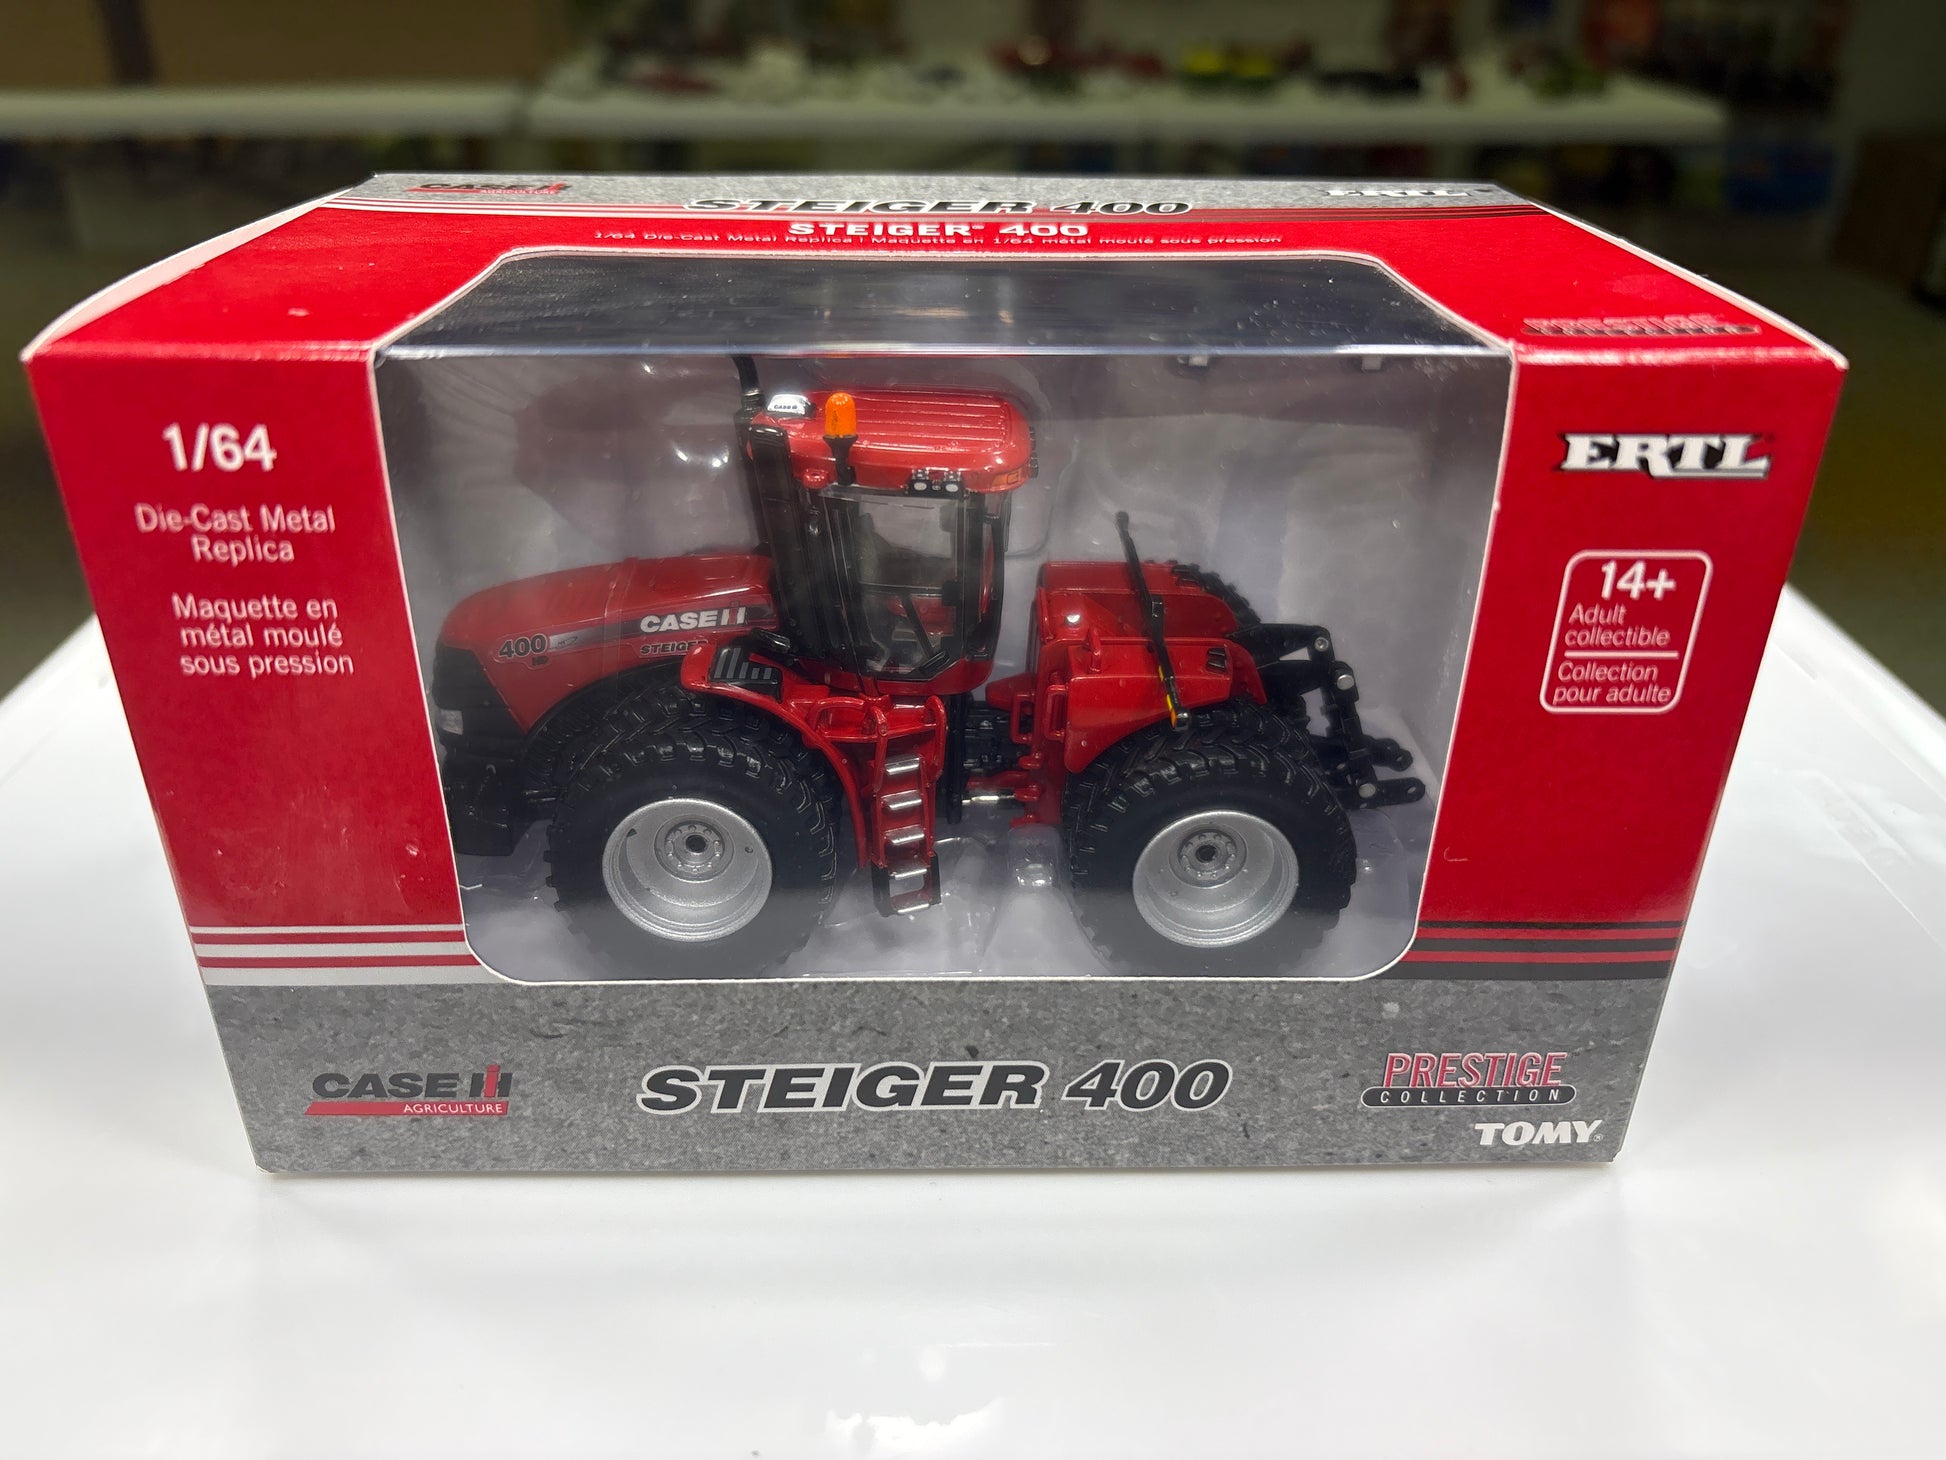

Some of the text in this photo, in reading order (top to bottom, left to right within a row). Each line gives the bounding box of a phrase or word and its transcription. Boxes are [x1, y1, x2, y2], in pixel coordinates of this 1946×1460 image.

[683, 198, 1193, 216] STEIGER 400
[594, 232, 636, 240] 1/64
[643, 233, 720, 242] Die-Cast
[728, 234, 777, 242] Metal
[785, 234, 852, 244] Replica
[872, 235, 956, 245] Maquette
[993, 236, 1034, 244] 1/64
[1042, 236, 1091, 244] métal
[1100, 236, 1154, 244] moulé
[1160, 236, 1201, 244] sous
[1207, 235, 1281, 244] pression
[999, 222, 1088, 236] 400
[162, 422, 277, 472] 1/64
[1557, 432, 1772, 479] ERTL
[134, 502, 336, 534] Die-Cast Metal
[190, 534, 295, 567] Replica
[1600, 560, 1676, 600] 14+
[171, 592, 338, 622] Maquette en
[1568, 602, 1627, 626] Adult
[640, 609, 718, 633] CASE
[180, 621, 343, 648] métal moulé
[498, 633, 547, 658] 400
[1564, 625, 1671, 647] collectible
[179, 650, 354, 679] sous pression
[1557, 660, 1658, 682] Collection
[1553, 683, 1672, 706] pour adulte
[1382, 1052, 1568, 1088] PRESTIGE
[311, 1072, 460, 1098] CASE
[635, 1058, 1234, 1115] STEIGER 400
[1380, 1089, 1560, 1104] COLLECTION
[402, 1102, 503, 1114] AGRICULTURE
